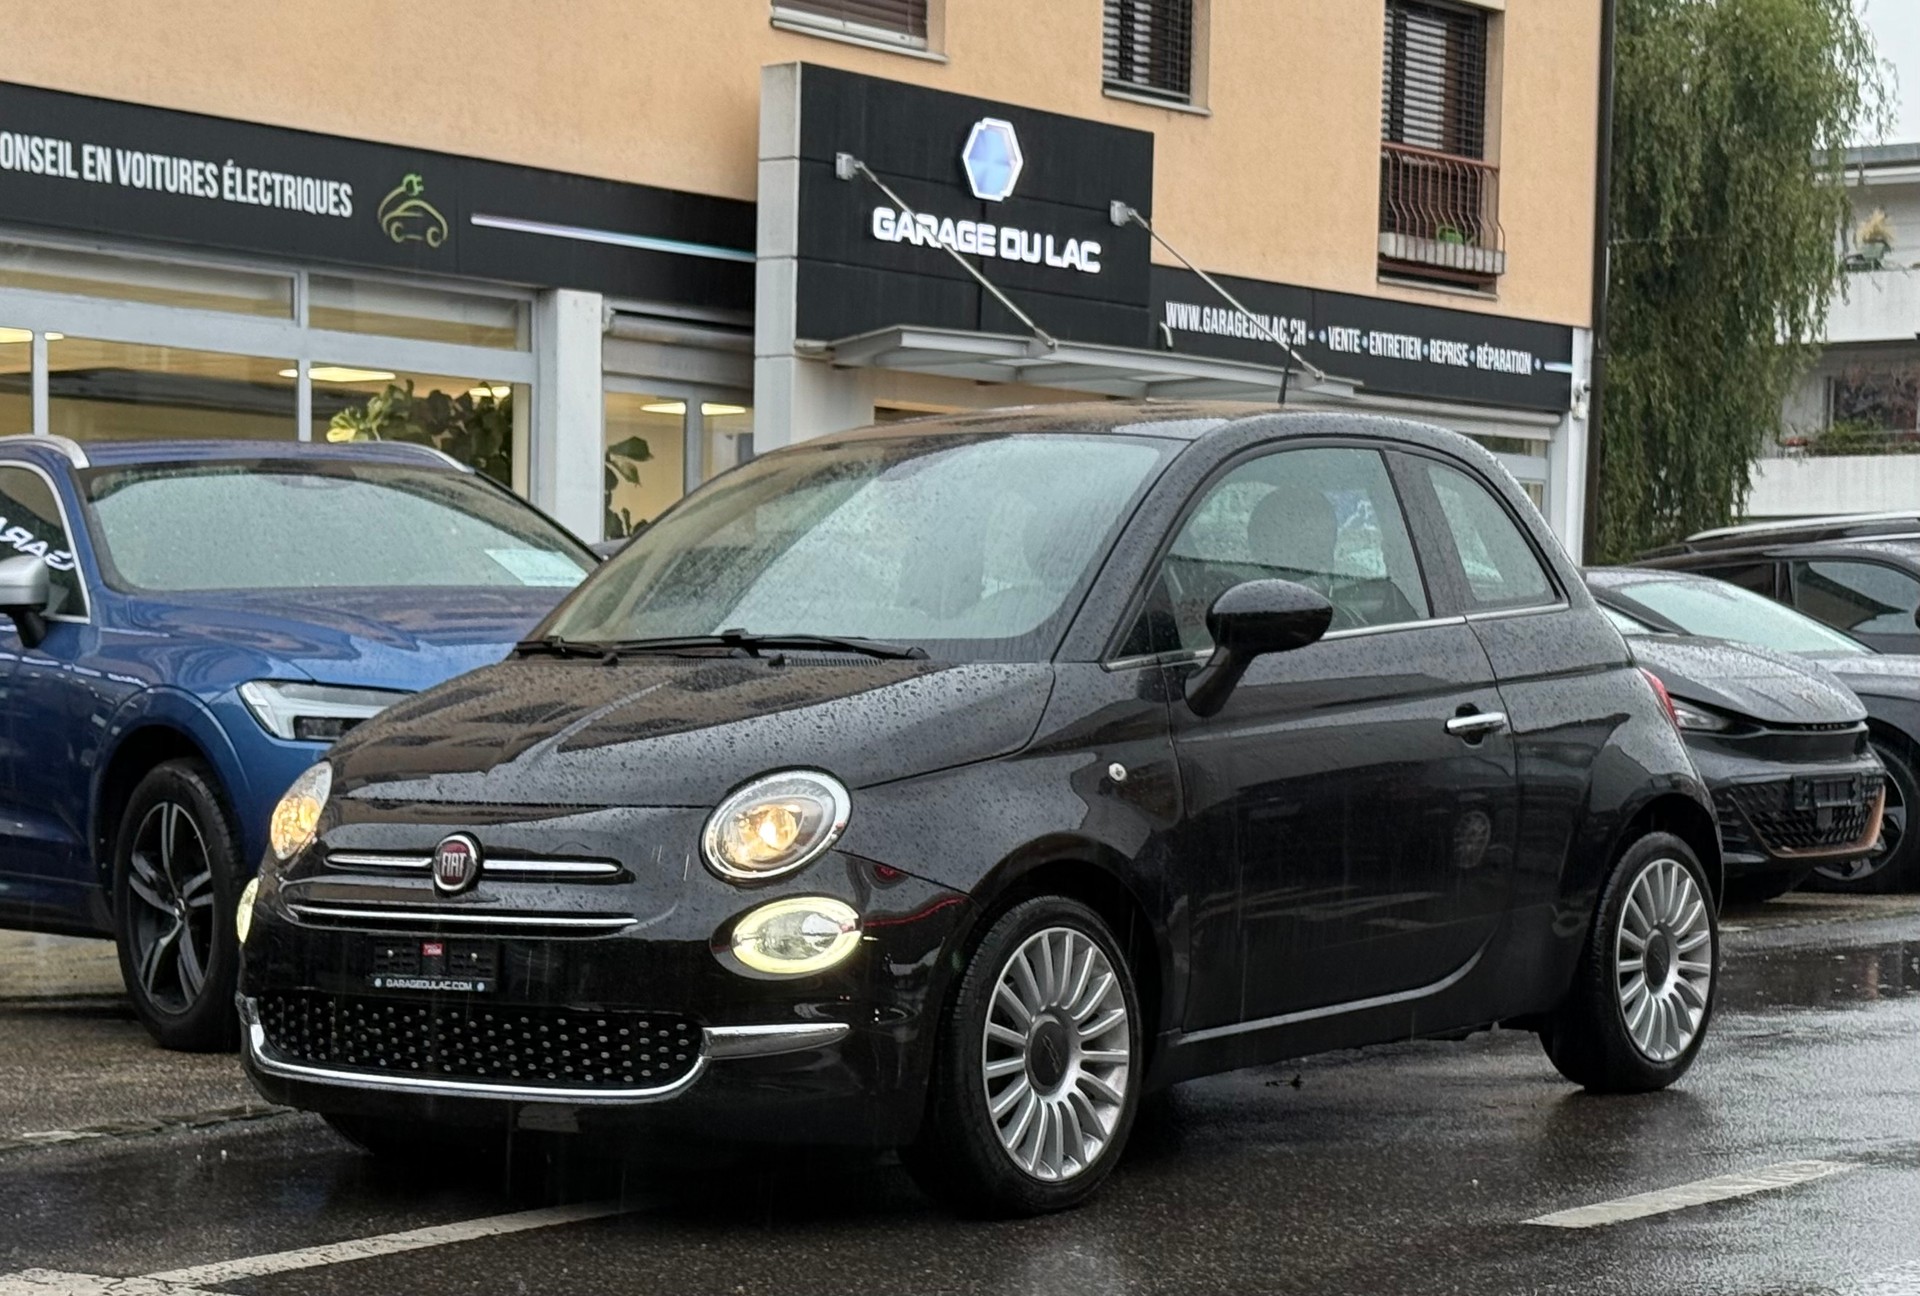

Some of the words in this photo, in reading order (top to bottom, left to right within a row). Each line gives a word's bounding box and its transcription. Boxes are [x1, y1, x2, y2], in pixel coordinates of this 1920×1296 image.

[0, 131, 78, 178] ONSEIL
[82, 143, 112, 184] EN
[116, 149, 218, 200] VOITURES
[223, 159, 353, 218] ÉLECTRIQUES
[872, 206, 996, 257] GARAGE
[1000, 227, 1041, 264] DU
[1045, 234, 1101, 274] LAC
[1165, 301, 1307, 346] WWW.GARAGEDULAC.CH
[1327, 326, 1361, 354] VENTE
[1368, 331, 1422, 362] ENTRETIEN
[1429, 339, 1469, 368] REPRISE
[1476, 342, 1532, 375] RÉPARATION
[441, 852, 467, 878] FIAT
[385, 978, 472, 991] GARAGEDULAC.COM
